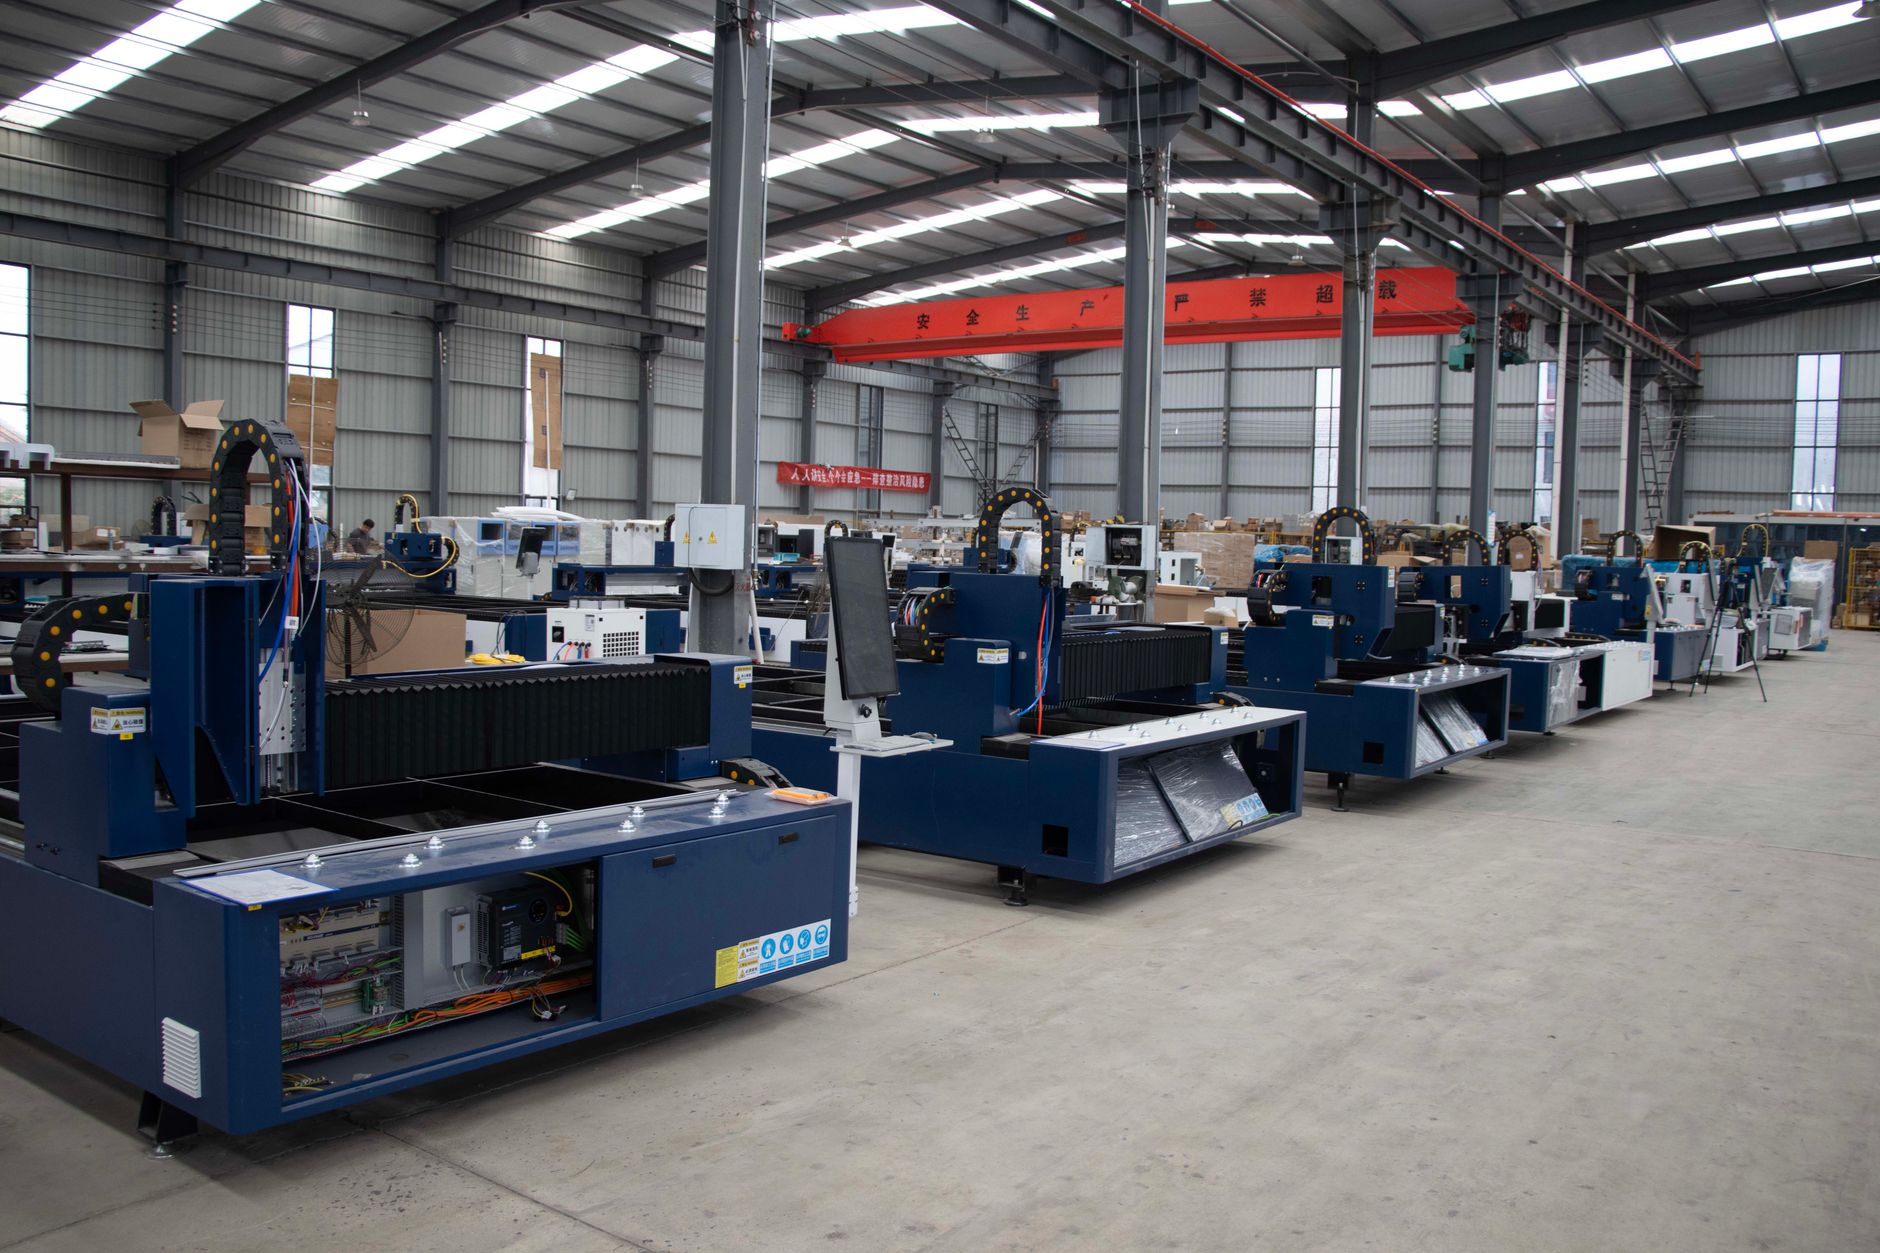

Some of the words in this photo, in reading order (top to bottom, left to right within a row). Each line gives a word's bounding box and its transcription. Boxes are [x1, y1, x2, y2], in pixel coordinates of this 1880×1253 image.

[916, 299, 1095, 330] 安全生产
[1174, 279, 1397, 312] 严禁超载
